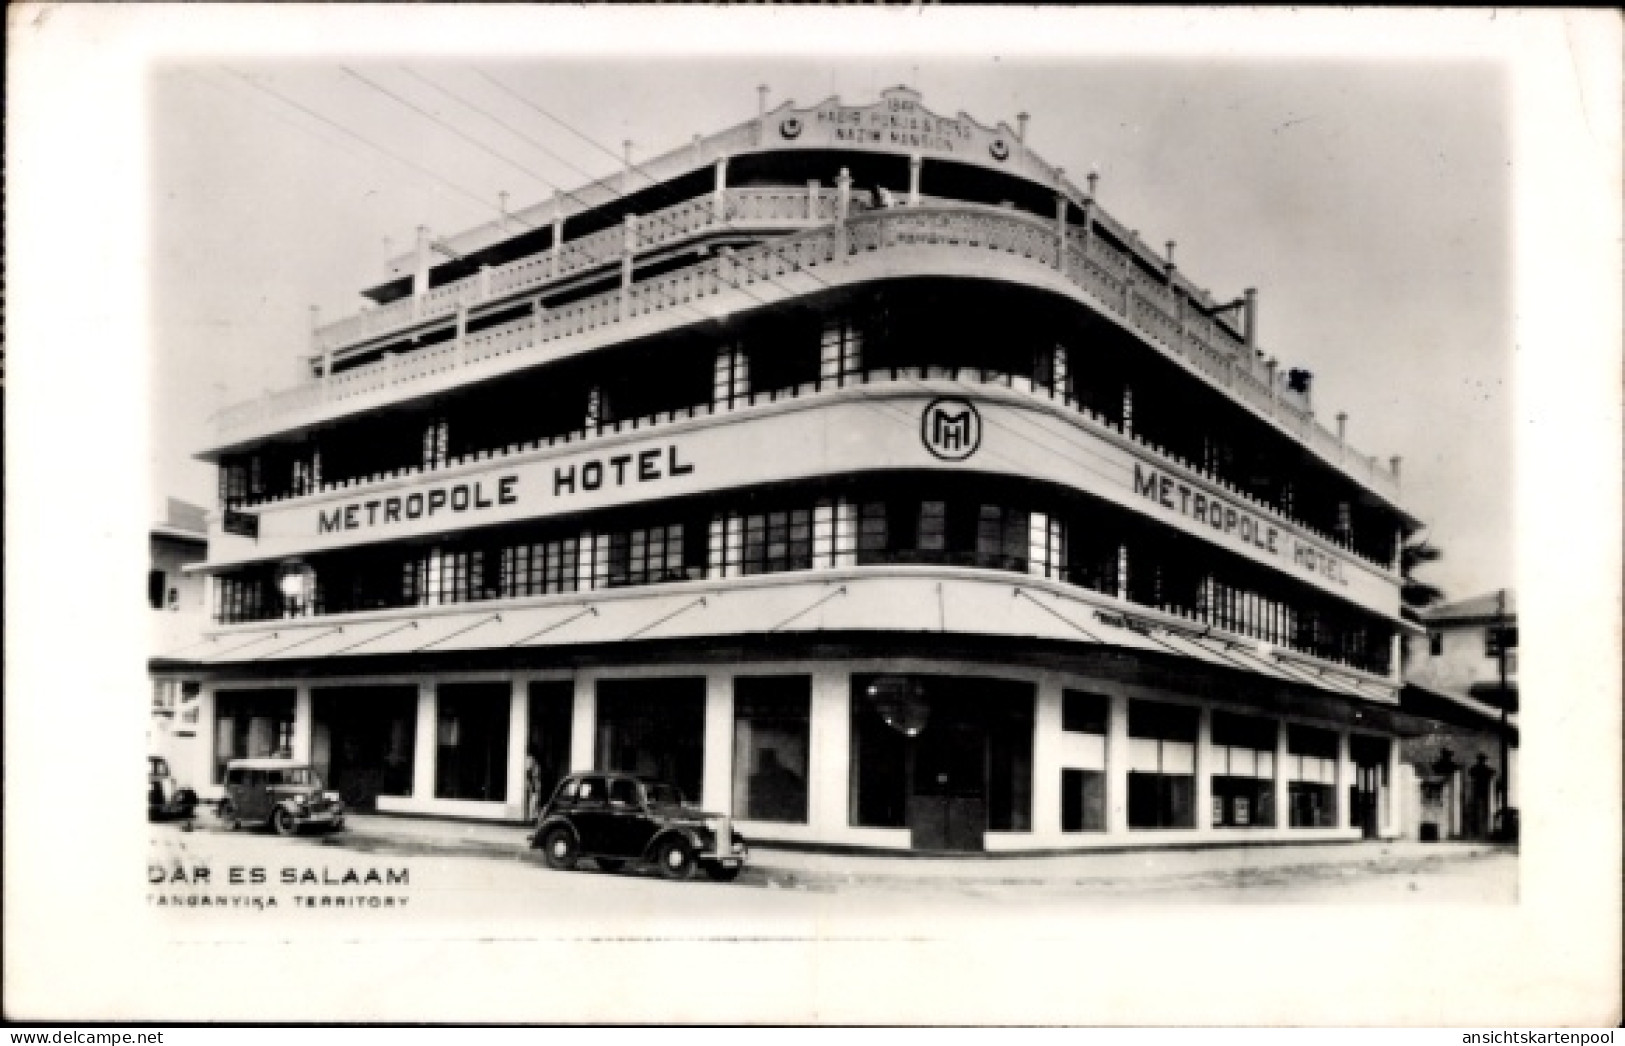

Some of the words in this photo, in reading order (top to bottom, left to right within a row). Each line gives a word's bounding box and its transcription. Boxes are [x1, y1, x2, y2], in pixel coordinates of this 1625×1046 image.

[317, 475, 519, 535] METROPOLE
[552, 445, 695, 497] HOTEL
[1134, 462, 1279, 555] METROPOLE
[1294, 538, 1349, 587] HOTEL
